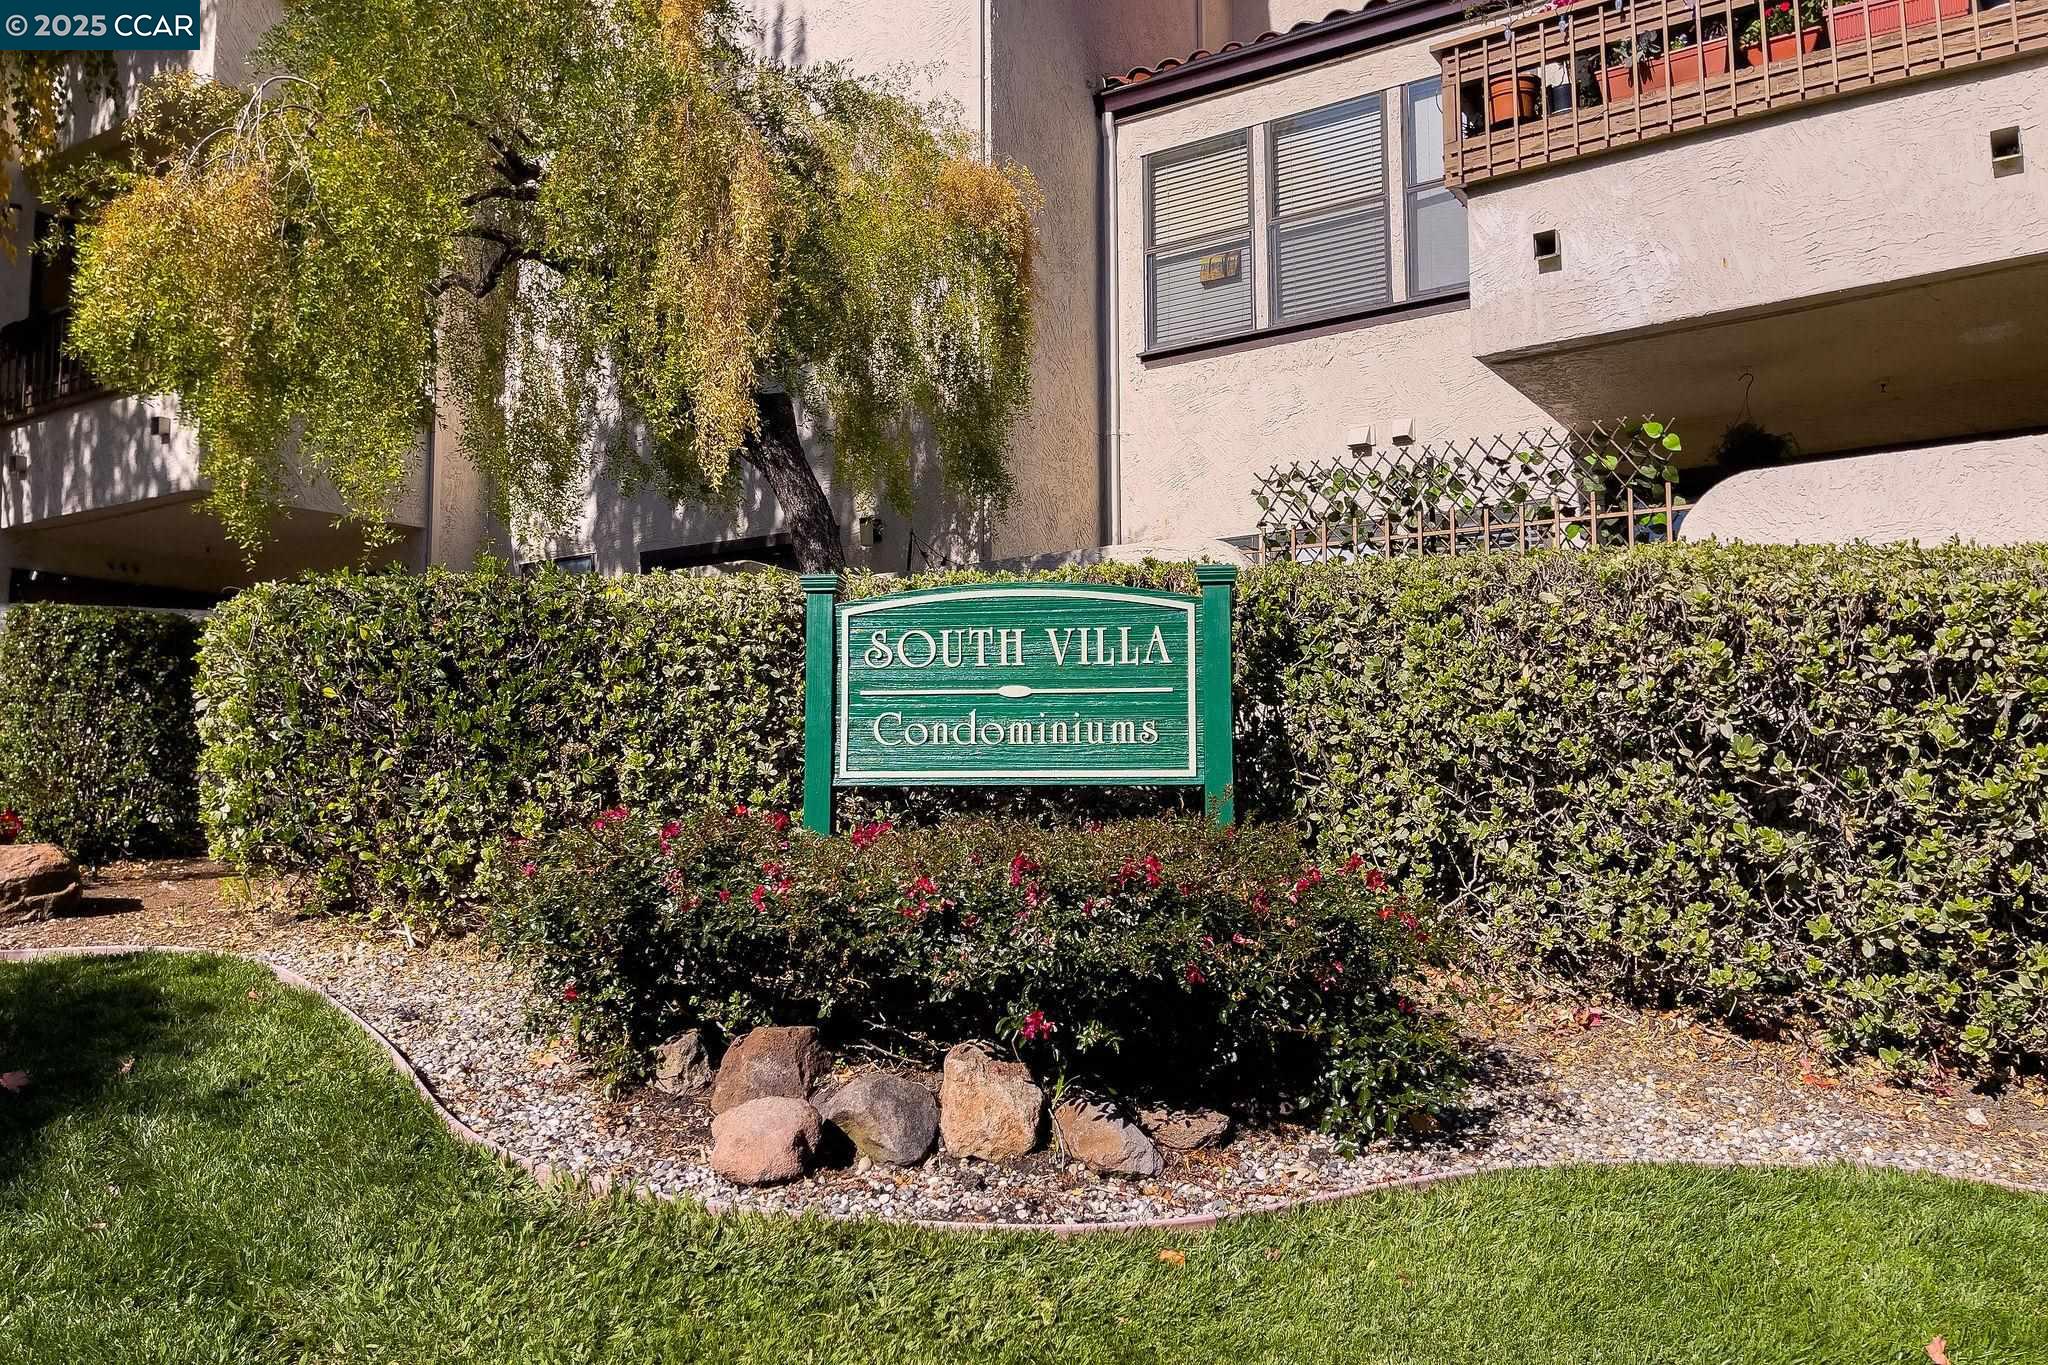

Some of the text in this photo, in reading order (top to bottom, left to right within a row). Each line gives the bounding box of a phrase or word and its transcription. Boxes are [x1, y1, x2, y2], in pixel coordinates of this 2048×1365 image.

[864, 625, 1173, 669] SOUTH VILLA
[873, 709, 1159, 747] Condominiums
